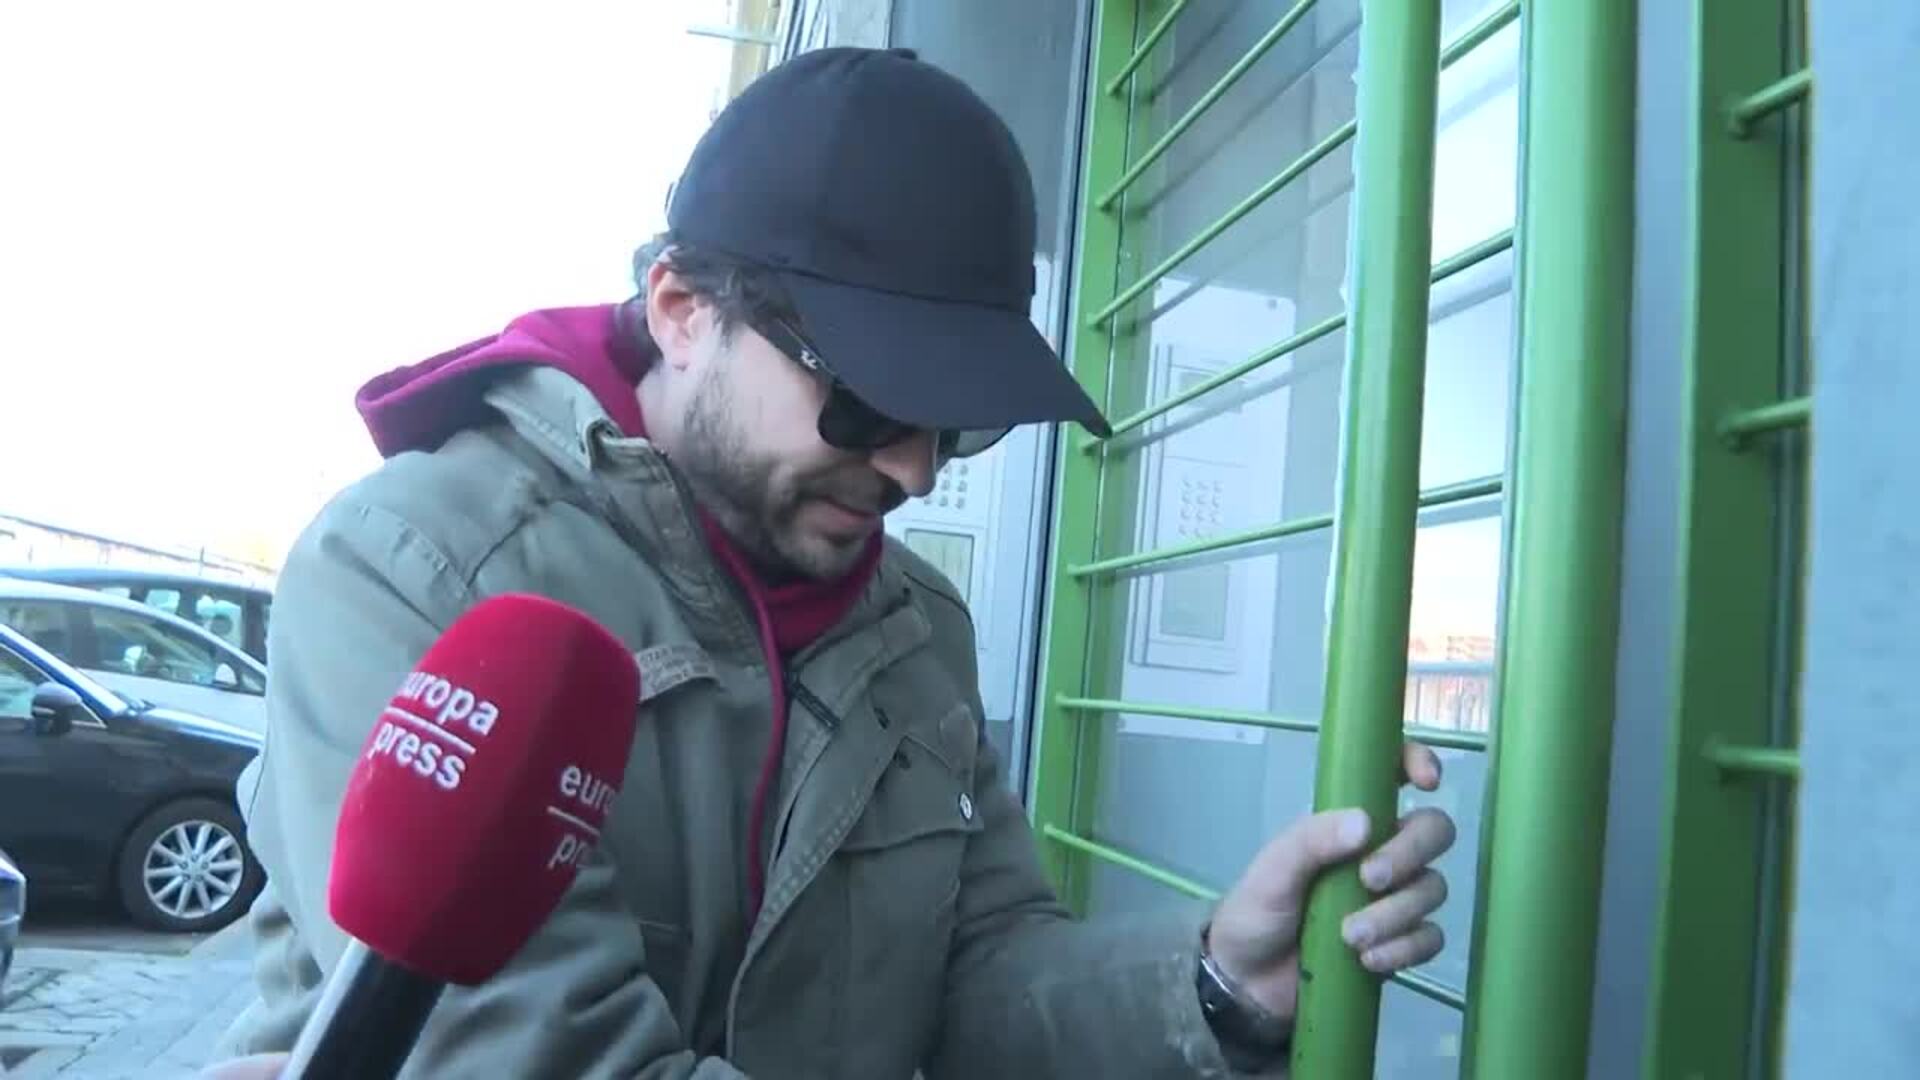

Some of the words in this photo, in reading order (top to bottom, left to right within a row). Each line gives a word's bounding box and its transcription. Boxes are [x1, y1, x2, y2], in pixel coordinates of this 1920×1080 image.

[399, 671, 499, 736] uropa
[367, 722, 466, 789] press
[547, 834, 591, 869] pr
